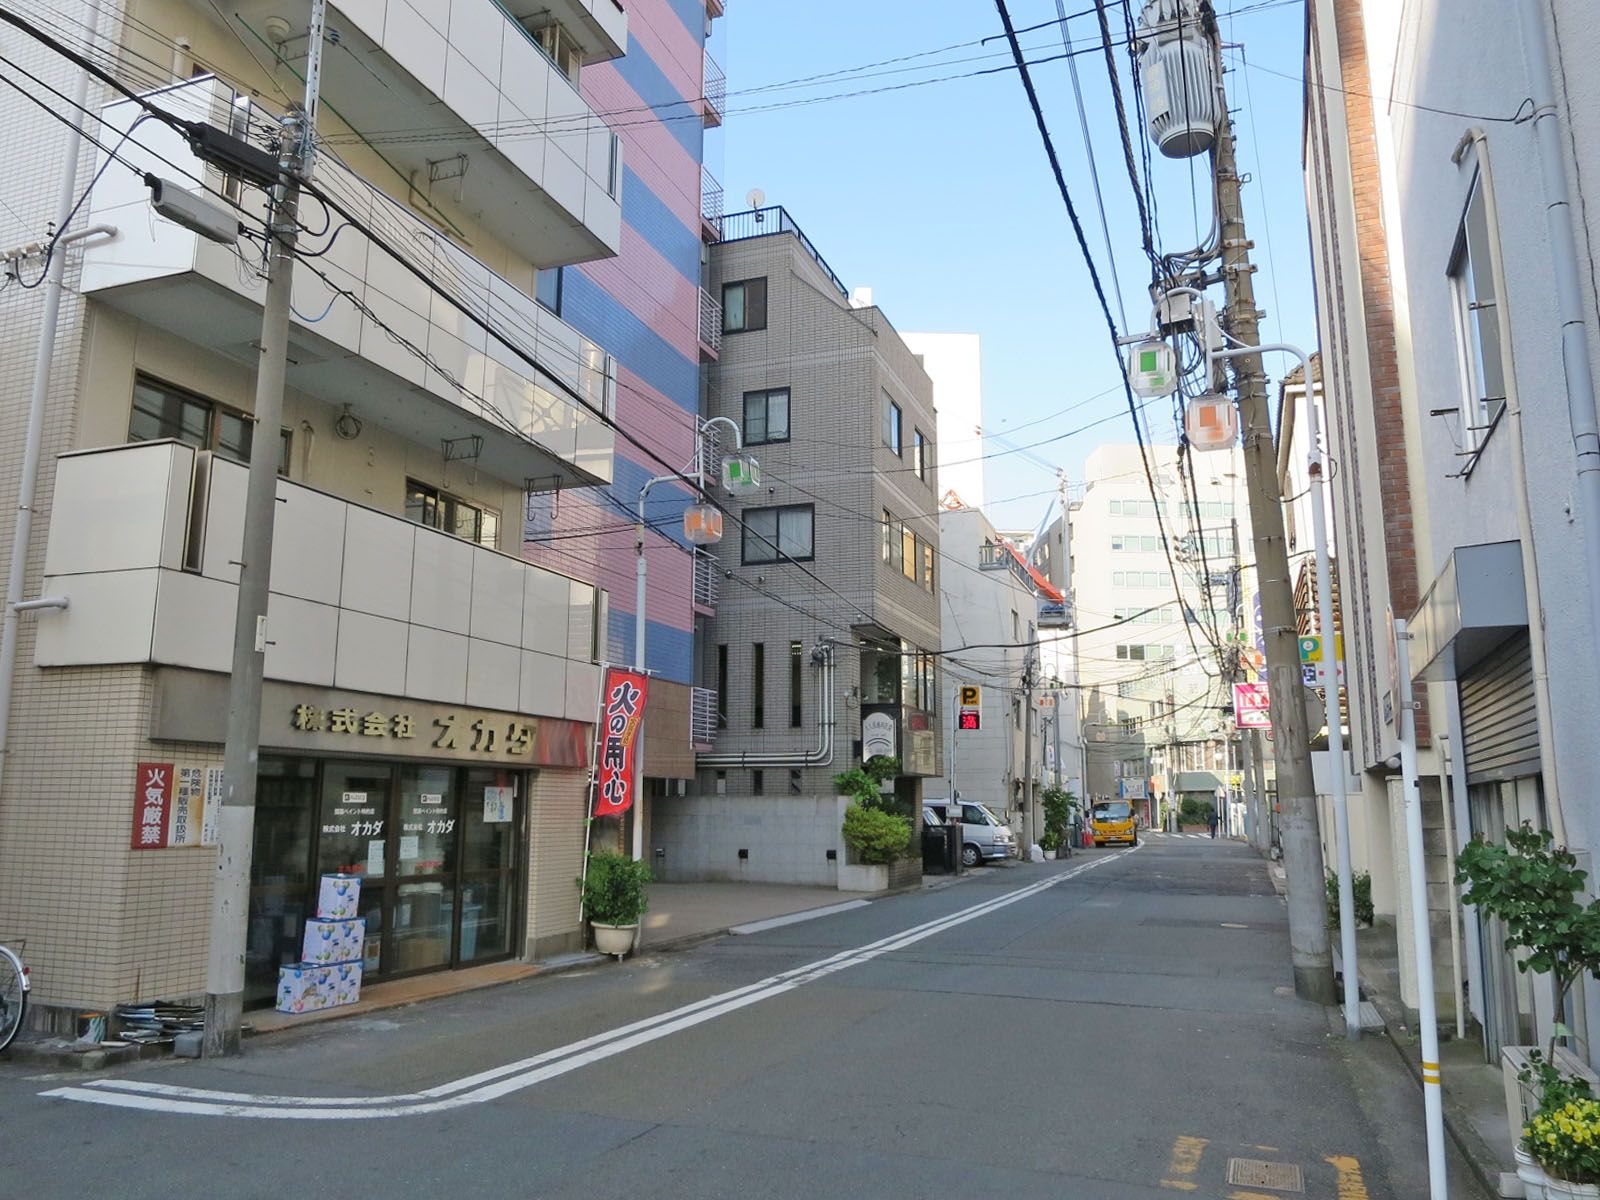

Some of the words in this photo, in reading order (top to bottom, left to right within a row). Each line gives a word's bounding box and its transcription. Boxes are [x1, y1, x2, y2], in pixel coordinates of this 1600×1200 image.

[962, 688, 977, 704] P
[291, 704, 416, 738] 株式会社
[604, 681, 641, 805] 火の用心
[141, 768, 165, 844] 火気厳禁
[350, 820, 384, 836] オカダ
[427, 819, 455, 834] オカダ
